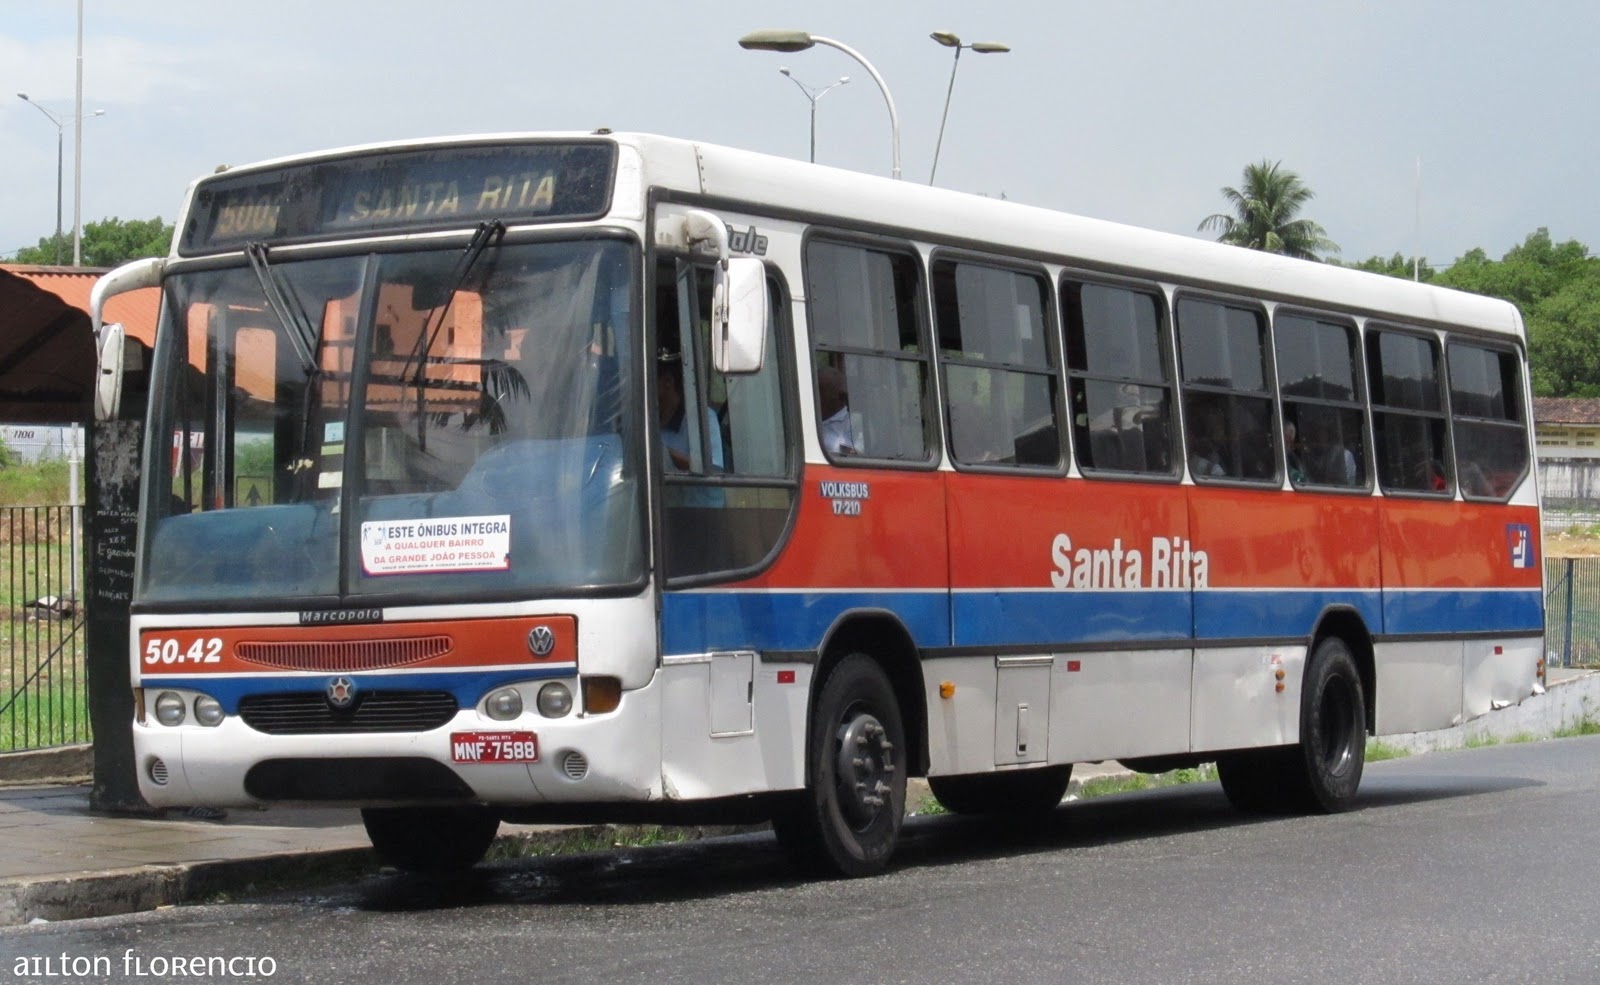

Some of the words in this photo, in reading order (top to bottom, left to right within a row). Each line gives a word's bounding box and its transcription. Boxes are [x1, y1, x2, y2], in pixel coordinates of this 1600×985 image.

[349, 181, 459, 221] SANTA
[477, 169, 554, 210] RITA
[821, 482, 868, 498] VOLKSBUS
[388, 525, 414, 538] ESTE
[418, 523, 457, 537] ÔNIBUS
[461, 522, 507, 535] INTEGRA
[385, 543, 392, 551] A
[394, 540, 446, 550] QUALQUER
[448, 539, 484, 548] BAIRRO
[374, 556, 386, 565] DA
[389, 554, 427, 564] GRANDE
[430, 552, 456, 561] JOÃO
[458, 551, 496, 560] PESSOA
[1051, 533, 1142, 588] Santa
[1152, 536, 1208, 588] Rita
[302, 609, 380, 622] Marcopolo
[144, 637, 223, 664] 50.42
